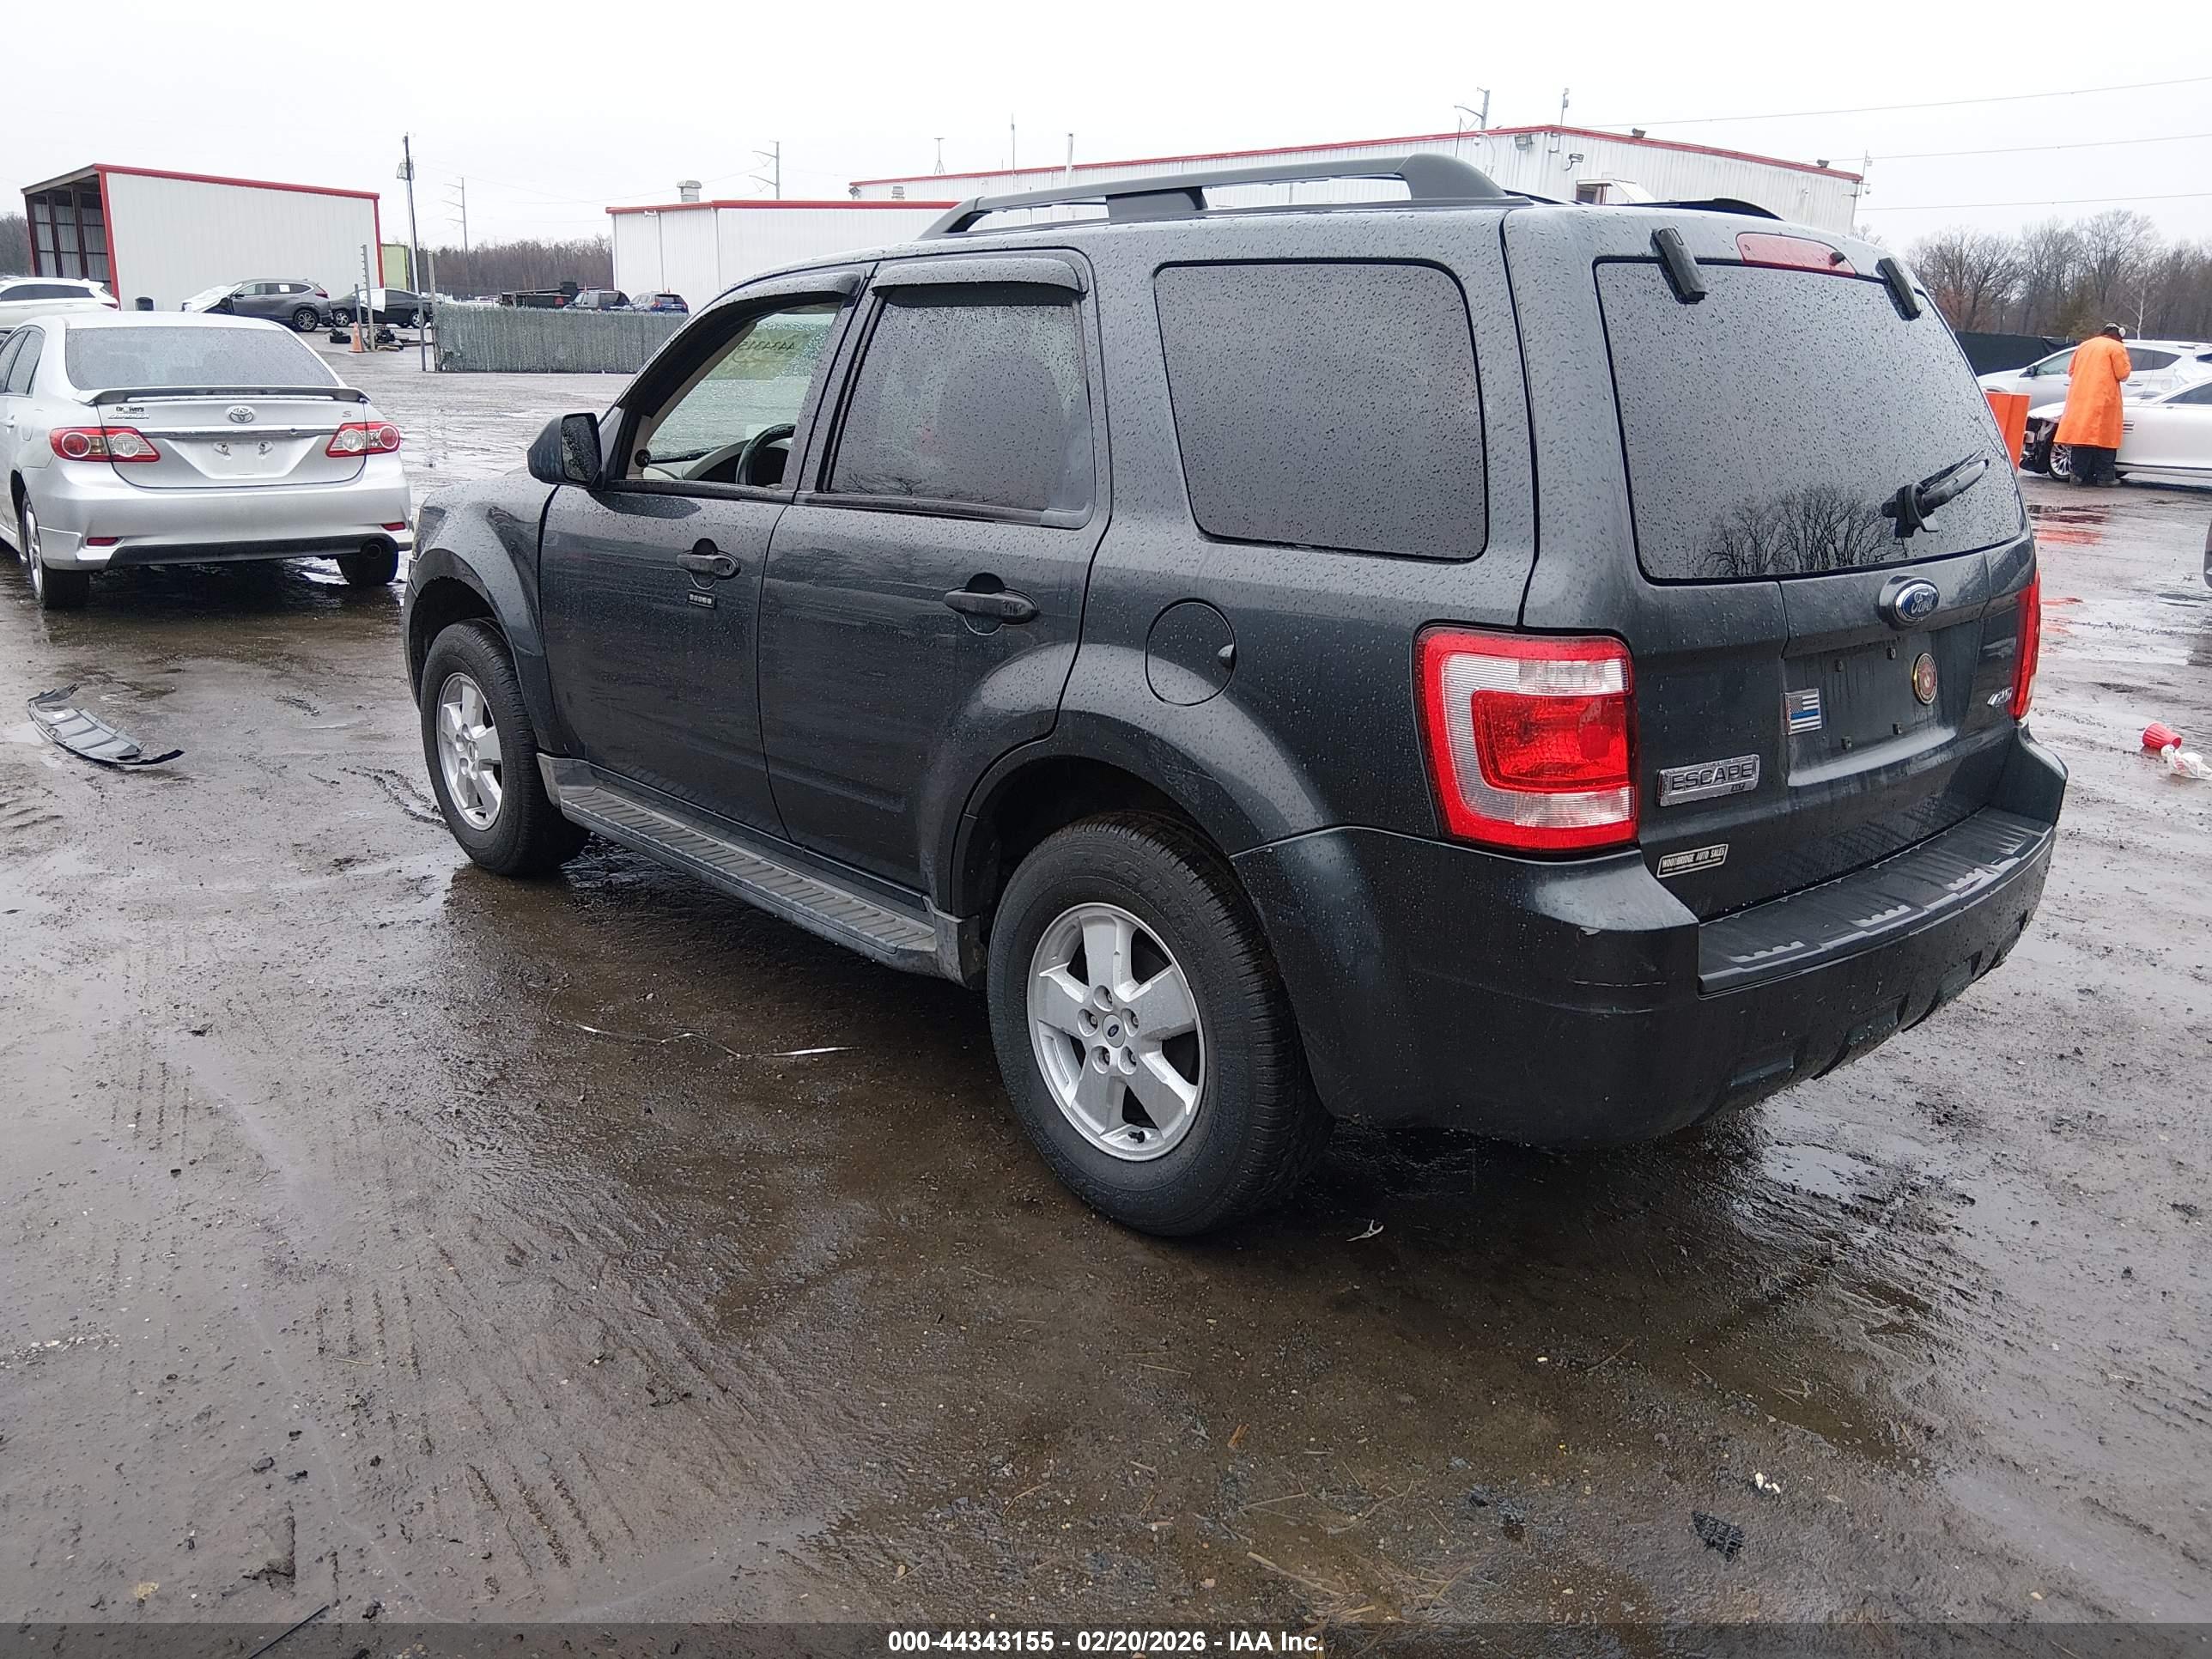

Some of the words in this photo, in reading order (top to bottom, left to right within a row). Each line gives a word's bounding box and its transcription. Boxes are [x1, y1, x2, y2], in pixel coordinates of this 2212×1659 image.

[1911, 591, 1935, 615] Ford
[1671, 762, 1753, 791] ESCAPE
[1695, 850, 1711, 862] AUTO
[1710, 847, 1725, 859] SALES
